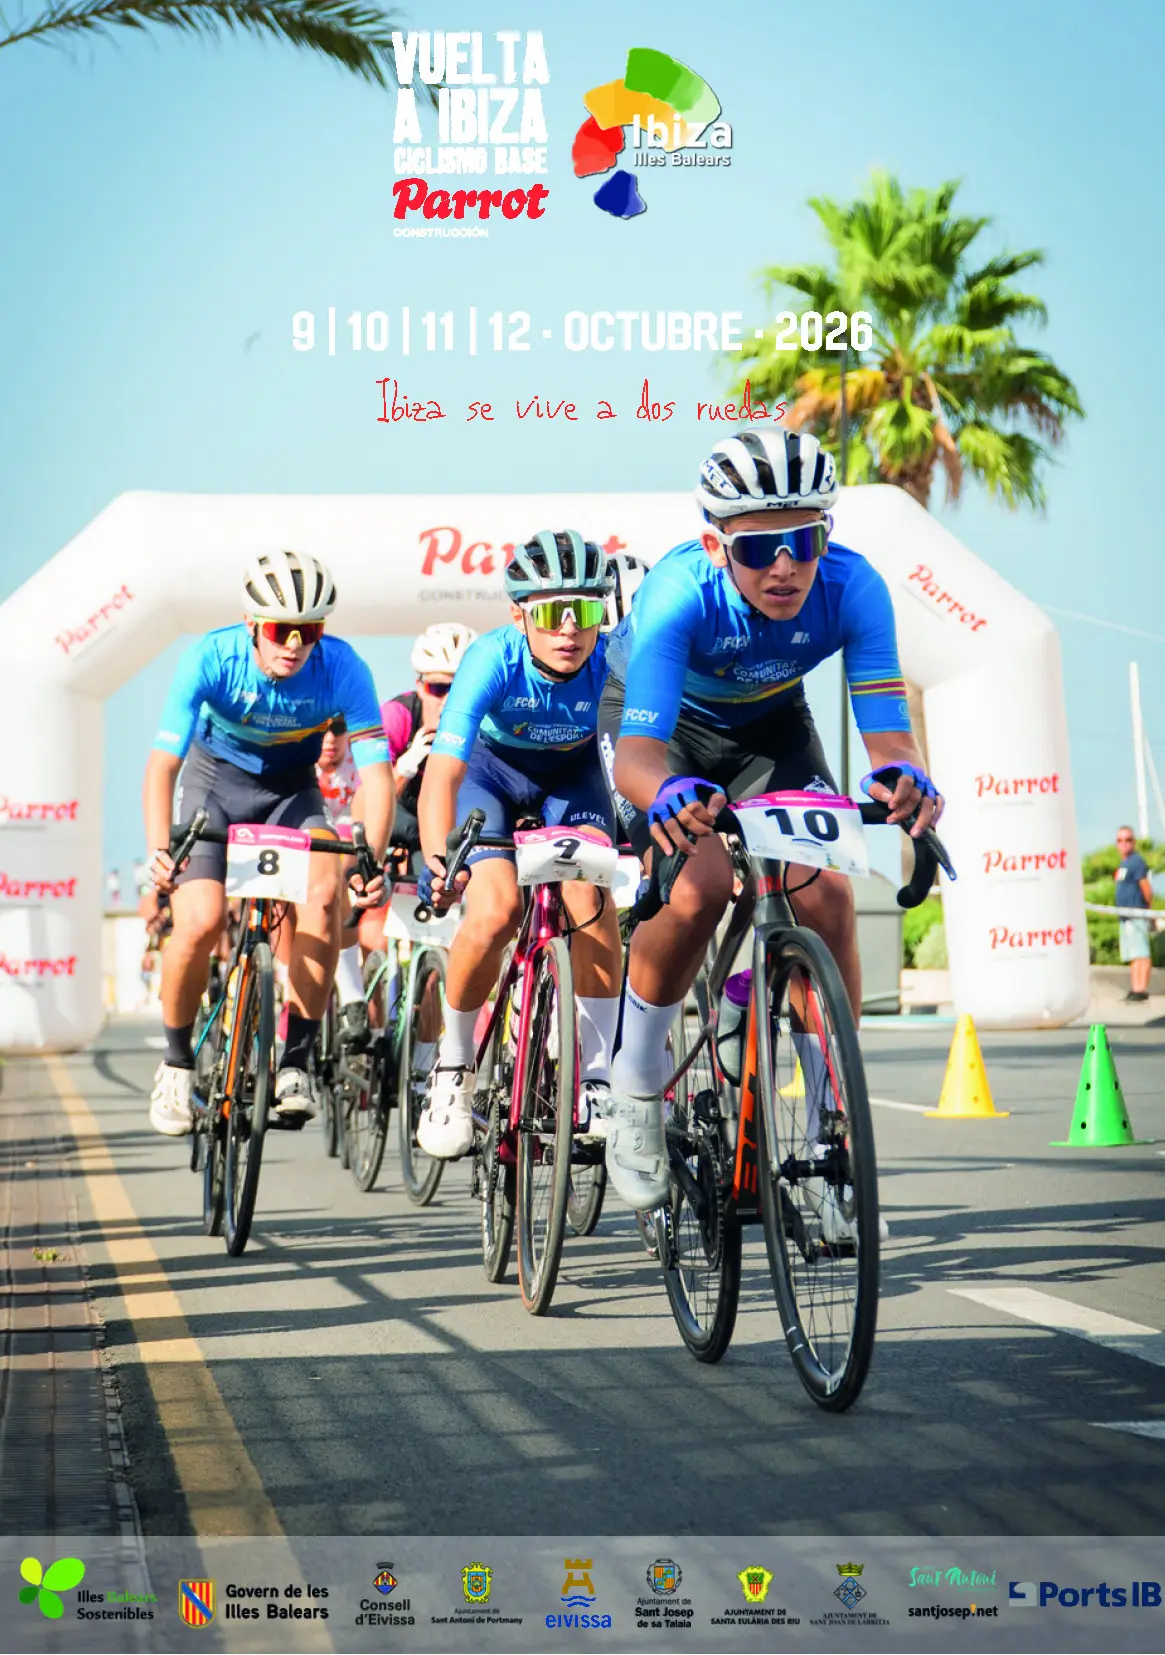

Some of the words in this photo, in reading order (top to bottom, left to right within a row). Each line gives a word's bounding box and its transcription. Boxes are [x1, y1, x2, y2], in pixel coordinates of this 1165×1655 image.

[908, 564, 988, 632] Parrot
[54, 584, 134, 655] Parrot
[974, 772, 1060, 798] Parrot
[763, 808, 841, 842] 10
[552, 838, 582, 860] 9
[982, 848, 1068, 874] Parrot
[257, 849, 279, 876] 8
[988, 924, 1075, 950] Parrot
